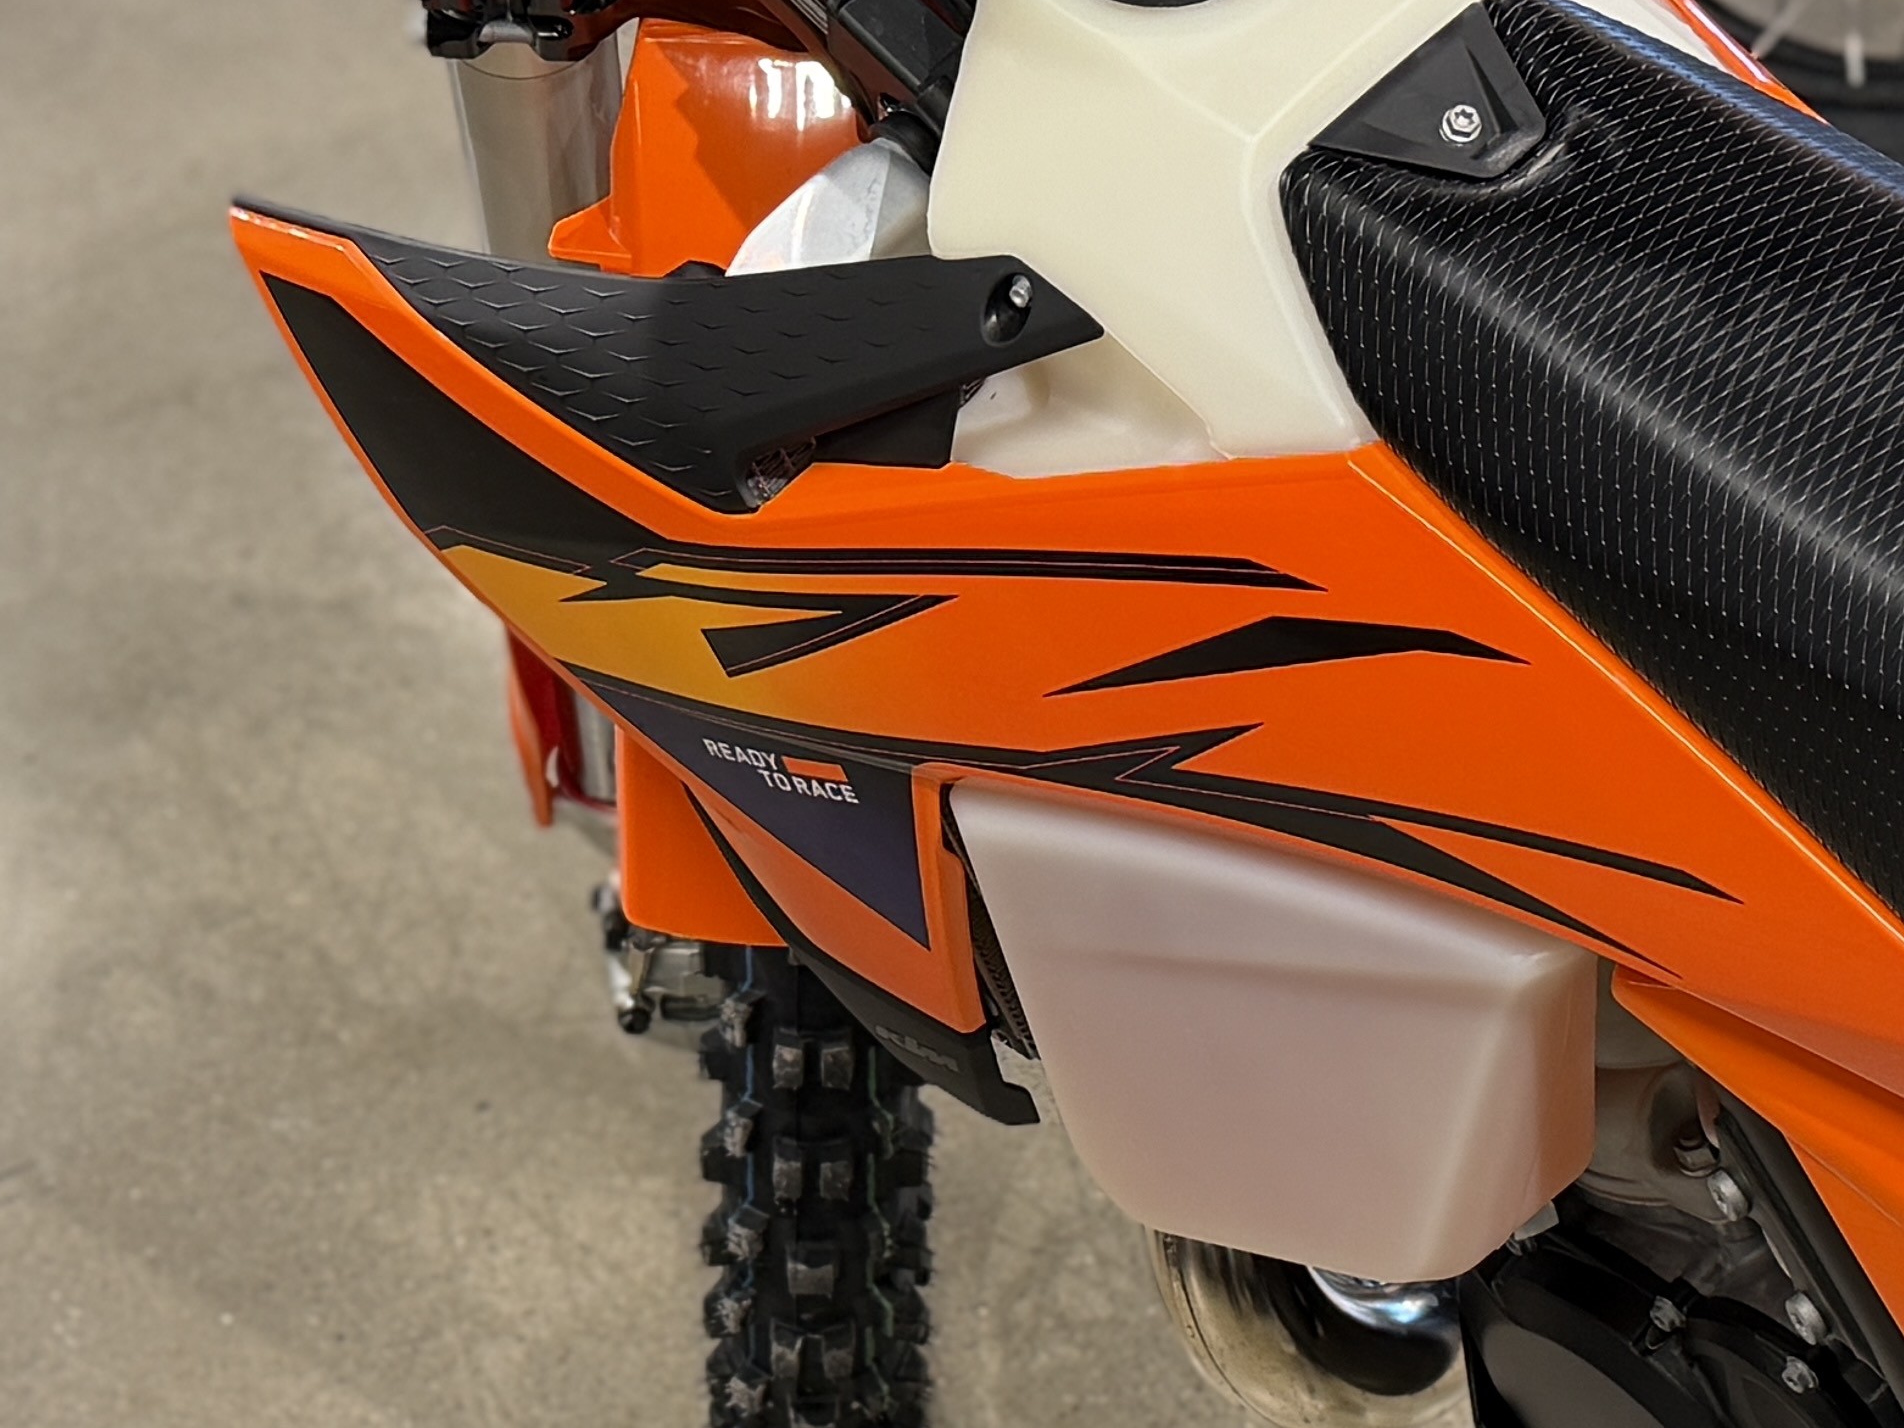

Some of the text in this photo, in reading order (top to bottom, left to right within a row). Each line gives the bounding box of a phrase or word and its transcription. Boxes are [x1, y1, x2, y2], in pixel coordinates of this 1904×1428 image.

[702, 738, 778, 771] READY
[756, 769, 861, 805] TO RACE
